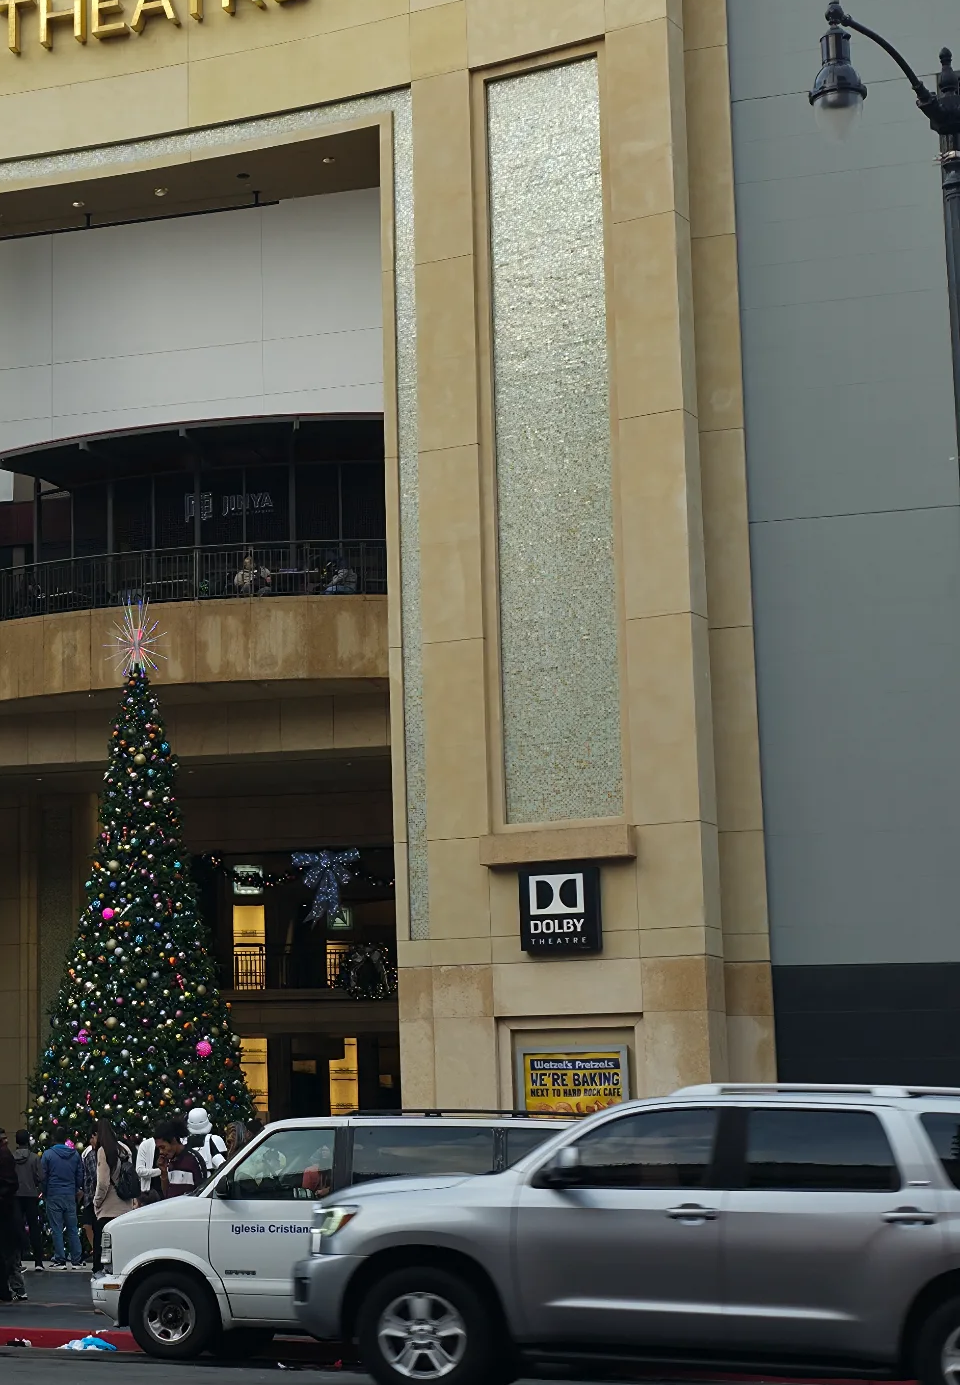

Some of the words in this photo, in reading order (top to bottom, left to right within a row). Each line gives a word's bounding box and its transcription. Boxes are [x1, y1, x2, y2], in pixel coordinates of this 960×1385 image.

[221, 491, 274, 517] JINYA
[530, 918, 585, 934] DOLBY
[531, 936, 587, 945] THEATRE
[534, 1060, 573, 1069] Wetzel's
[575, 1059, 614, 1069] Pretzels
[530, 1072, 568, 1087] WE'RE
[573, 1071, 620, 1087] BAKING
[530, 1088, 549, 1097] NEXT
[552, 1088, 561, 1097] TO
[563, 1088, 581, 1097] HARD
[583, 1087, 602, 1097] ROCK
[603, 1087, 621, 1097] CAFE
[231, 1223, 266, 1235] Iglesia
